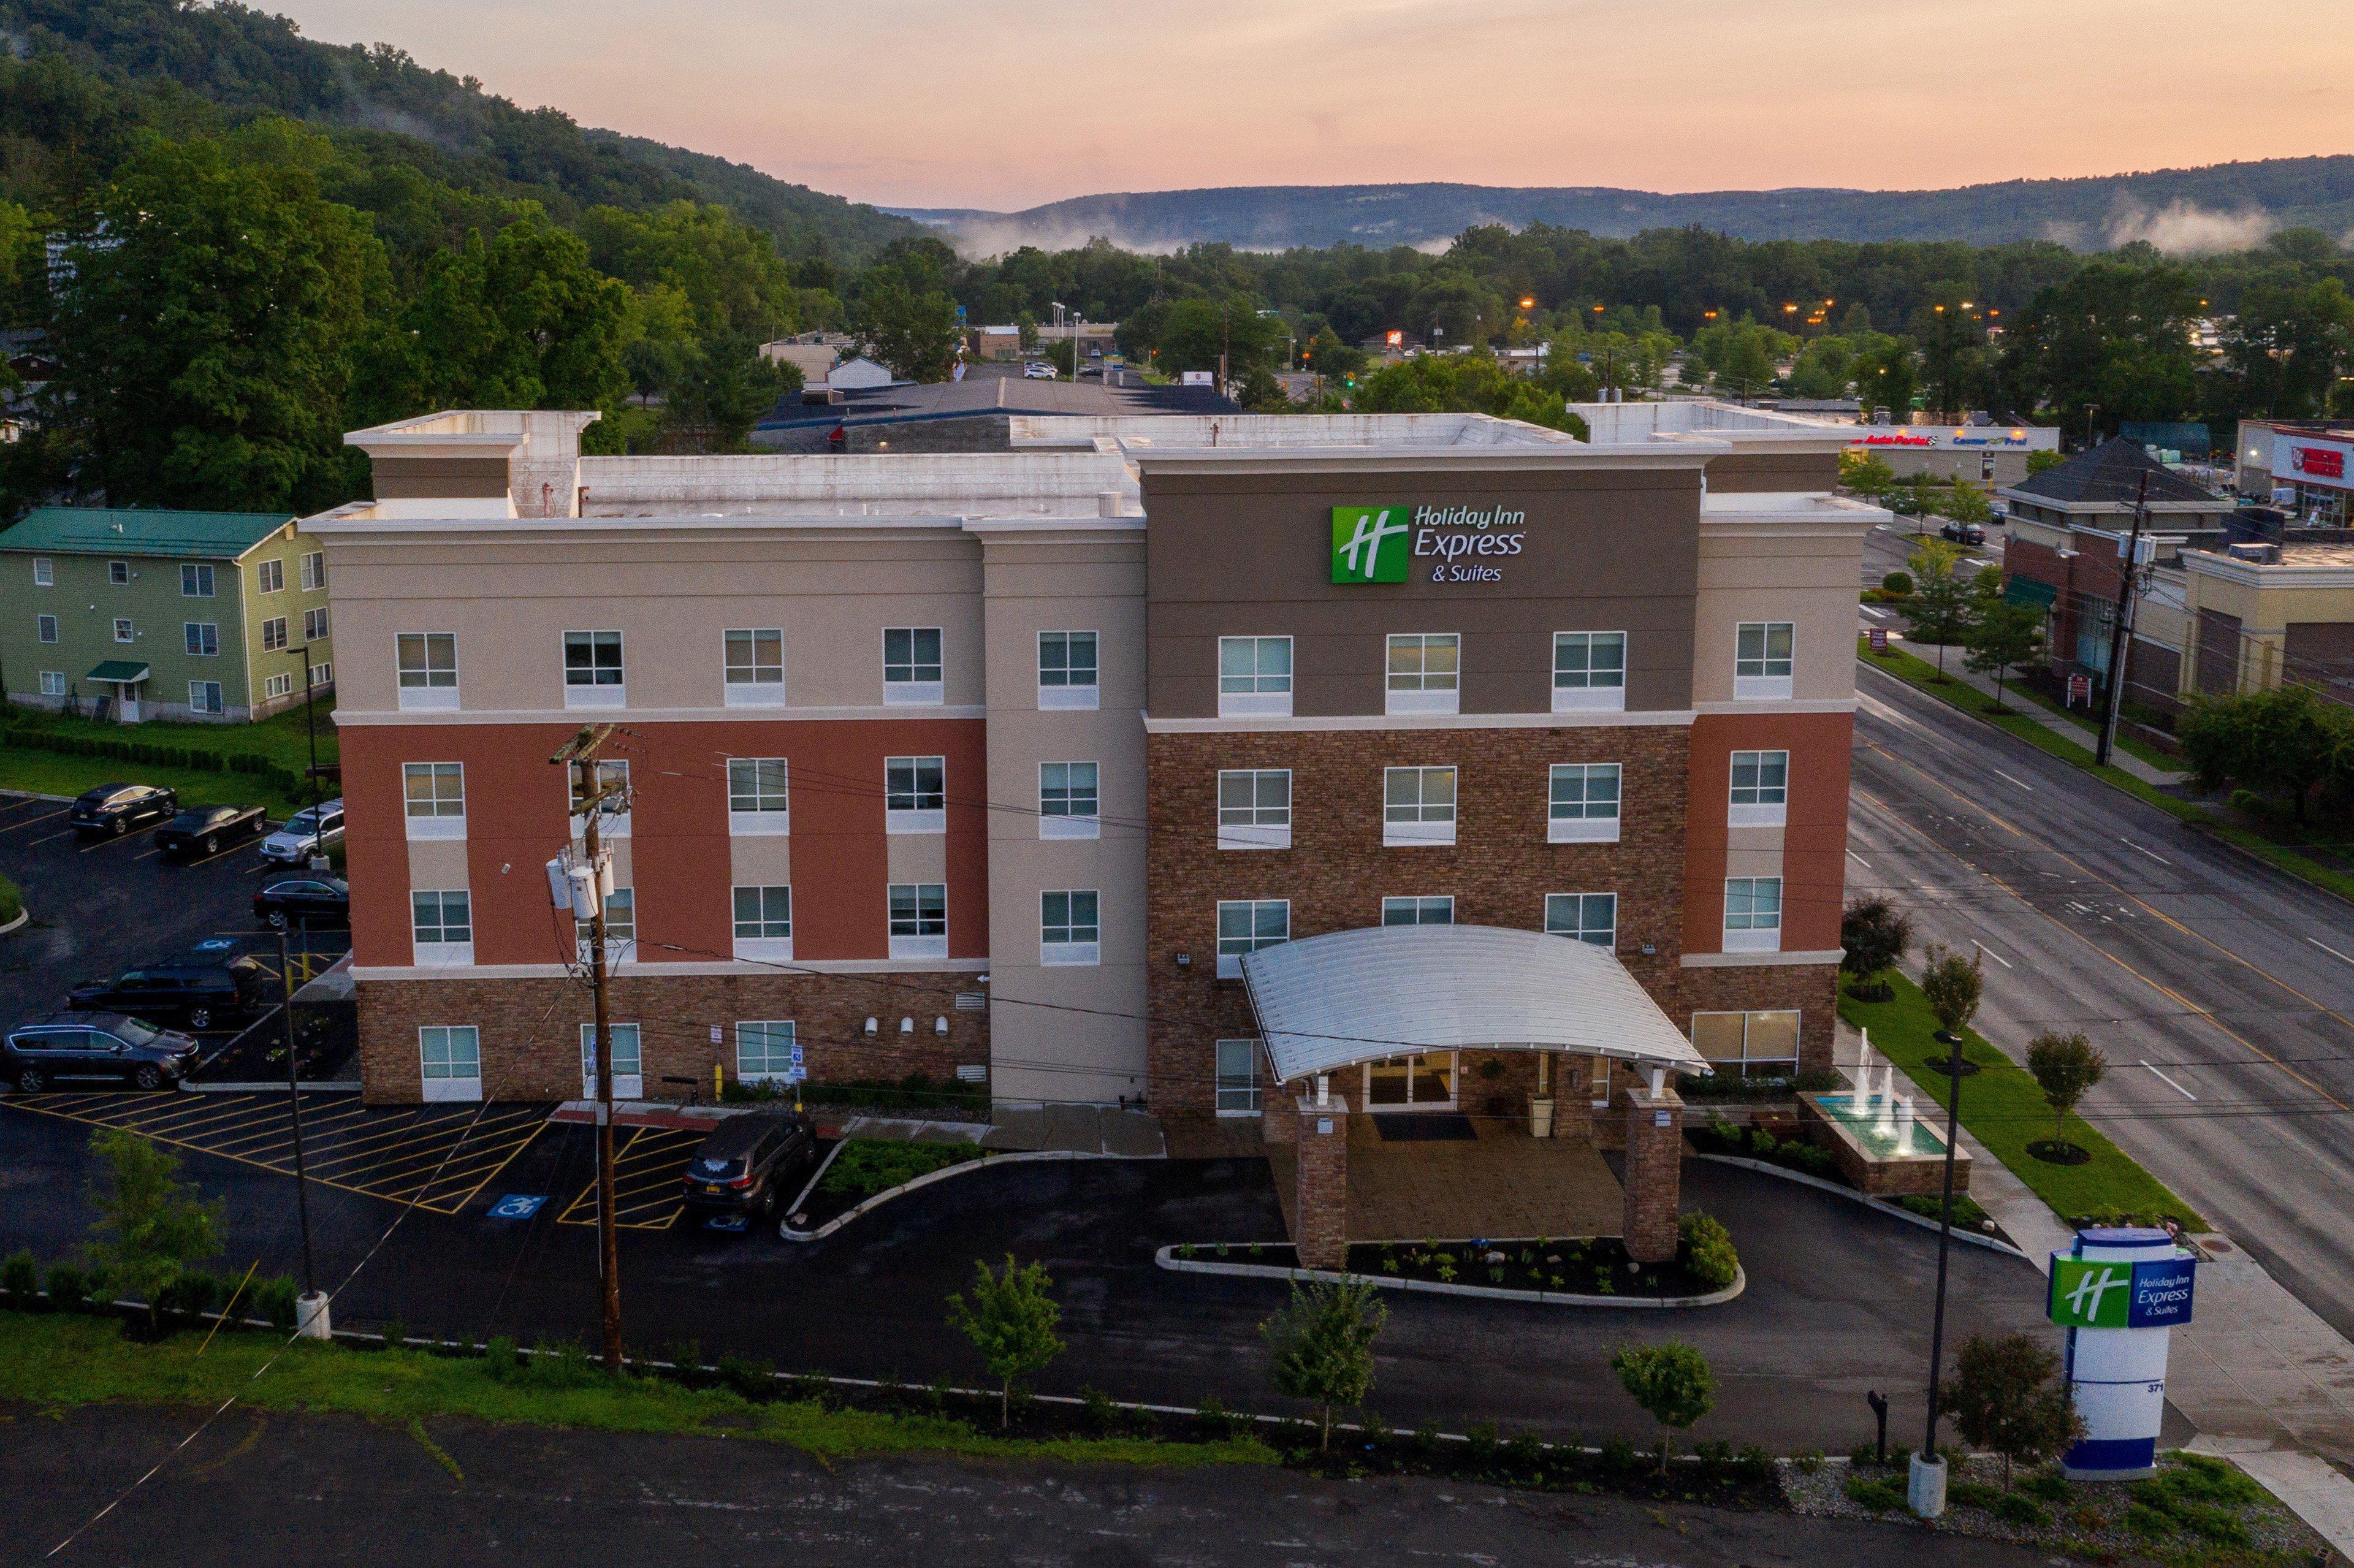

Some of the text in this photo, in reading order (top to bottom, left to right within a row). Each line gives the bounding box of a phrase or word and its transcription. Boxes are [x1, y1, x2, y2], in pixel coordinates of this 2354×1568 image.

[1865, 435, 1893, 444] Auto
[1415, 505, 1525, 529] Holiday Inn
[1414, 528, 1525, 563] Express
[1432, 565, 1502, 582] & Suites
[2139, 1275, 2189, 1288] Holiday Inn
[2138, 1288, 2188, 1306] Express
[2146, 1306, 2179, 1315] & Suites
[2147, 1383, 2164, 1393] 371
